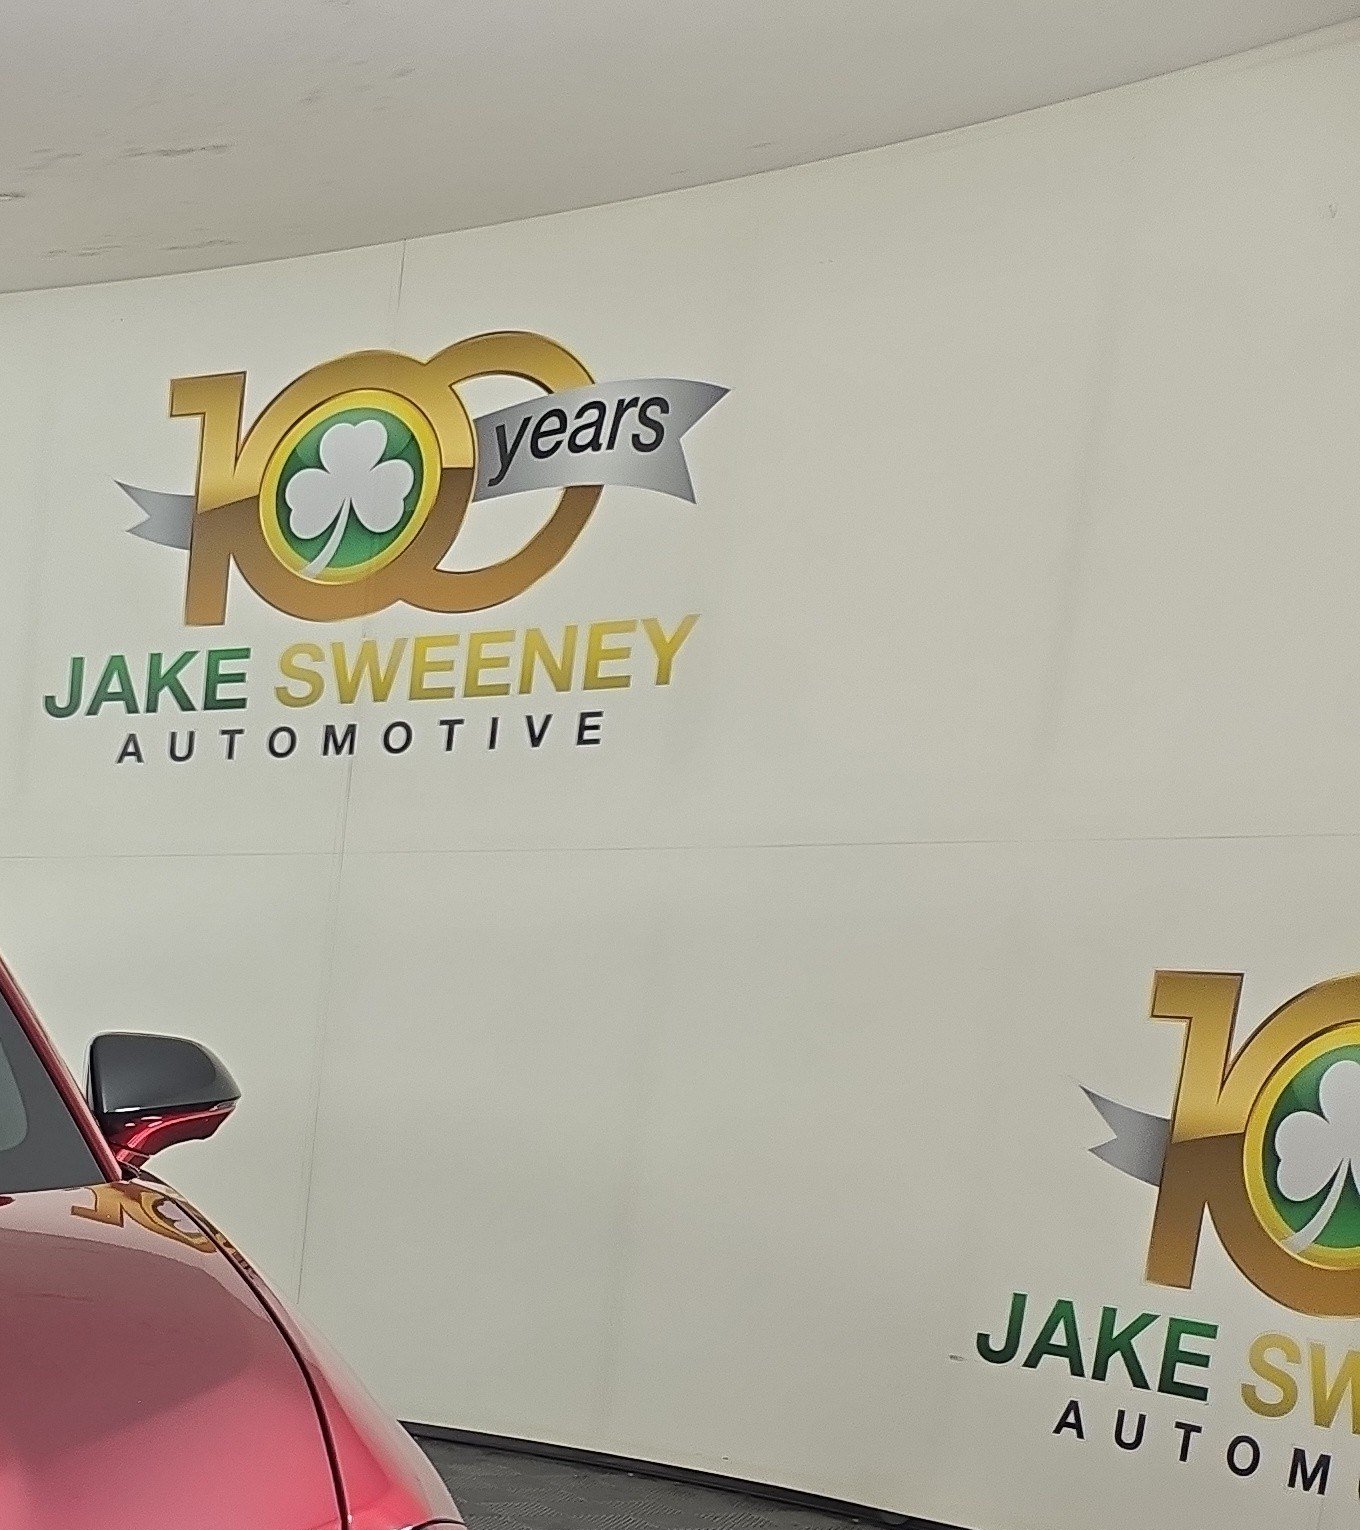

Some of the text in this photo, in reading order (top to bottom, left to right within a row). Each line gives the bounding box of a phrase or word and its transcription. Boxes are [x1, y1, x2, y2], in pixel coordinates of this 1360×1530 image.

[169, 330, 606, 627] 100
[487, 394, 671, 487] years
[43, 613, 702, 720] JAKE SWEENEY
[115, 710, 606, 765] AUTOMOTIVE
[1144, 969, 1360, 1319] 10
[975, 1291, 1360, 1435] JAKE SW
[1052, 1399, 1360, 1500] AUTOM
